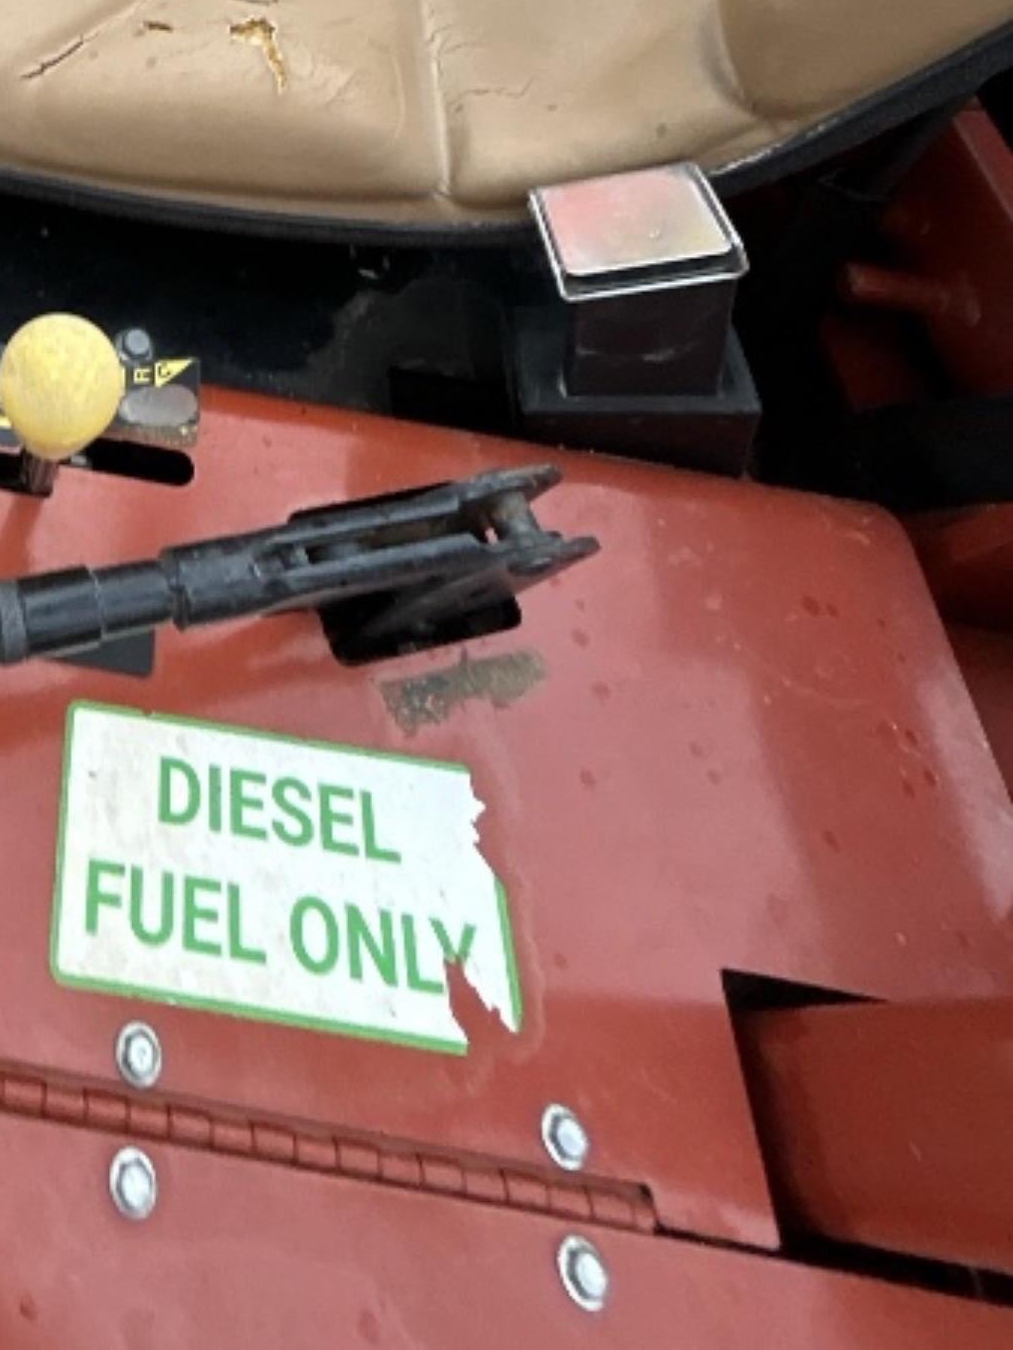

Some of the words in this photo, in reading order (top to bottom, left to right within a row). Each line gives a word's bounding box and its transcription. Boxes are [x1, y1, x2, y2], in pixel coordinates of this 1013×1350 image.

[157, 755, 402, 864] DIESEL
[85, 858, 267, 966] FUEL
[290, 896, 476, 995] ONLY
